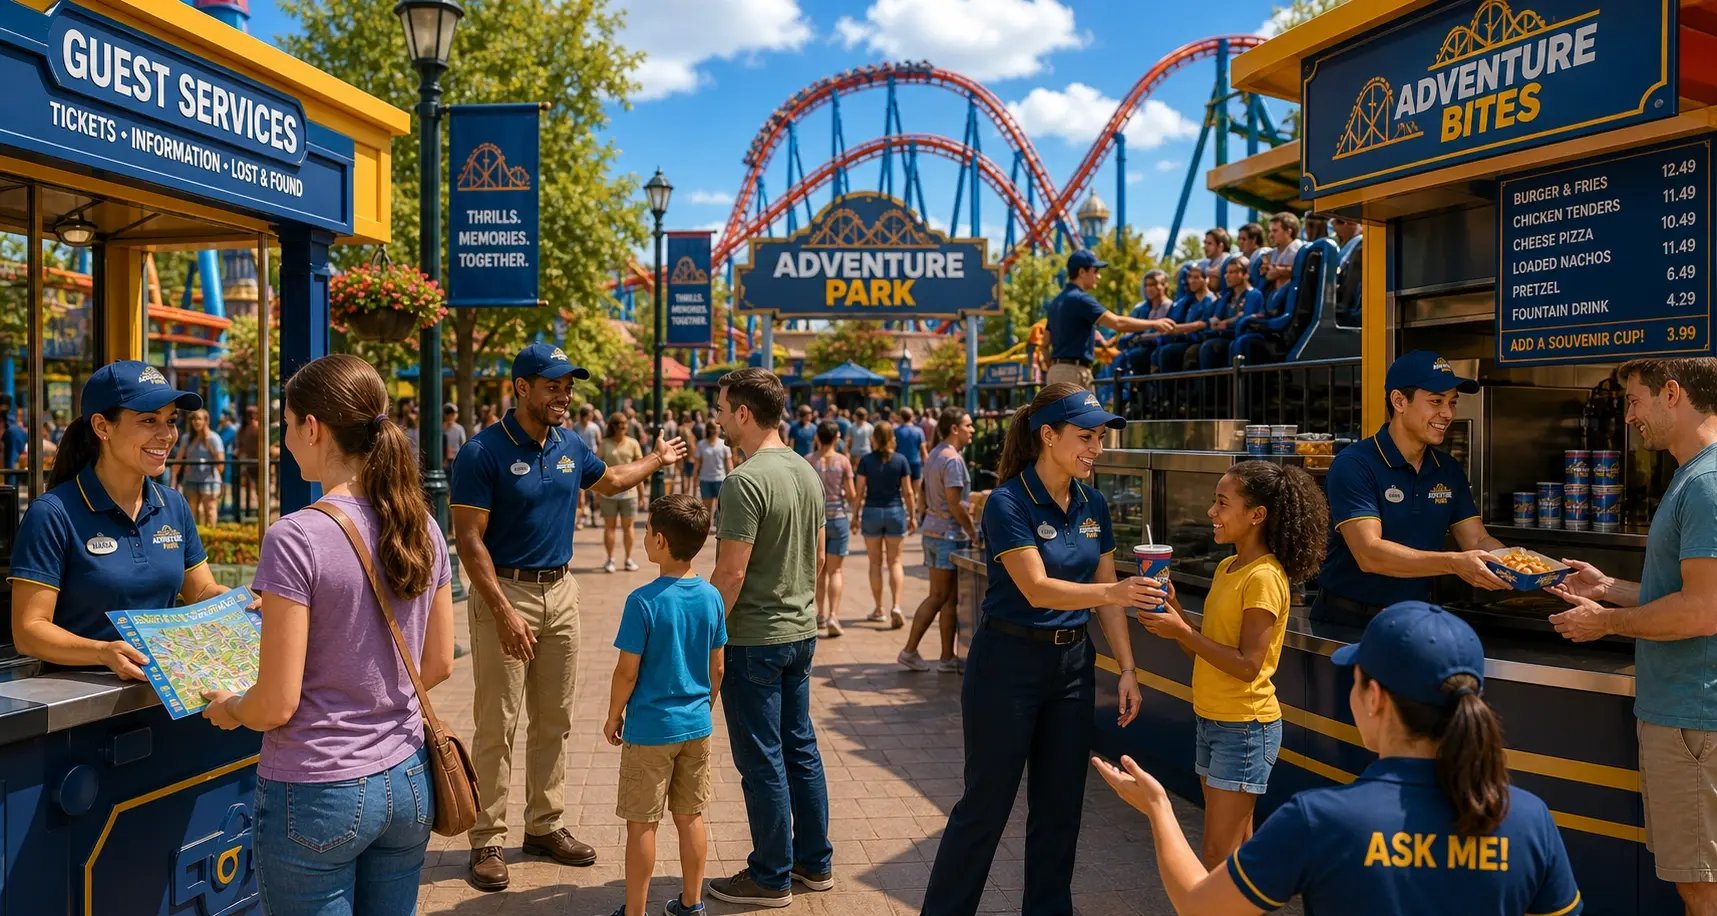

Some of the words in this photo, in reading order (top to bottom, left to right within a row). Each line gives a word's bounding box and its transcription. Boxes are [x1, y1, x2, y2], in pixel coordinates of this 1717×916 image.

[1394, 22, 1598, 120] ADVENTURE
[62, 28, 170, 108] GUEST
[178, 73, 297, 154] SERVICES
[1440, 82, 1543, 143] BITES
[49, 101, 117, 143] TICKETS
[131, 127, 221, 173] INFORMATION
[231, 158, 258, 183] LOST
[260, 170, 268, 187] &
[270, 173, 303, 197] FOUND
[1514, 186, 1559, 205] BURGER
[1563, 184, 1571, 196] &
[1575, 176, 1608, 194] FRIES
[1662, 159, 1696, 178] 12.49
[466, 209, 521, 224] THRILLS.
[1513, 209, 1563, 228] CHICKEN
[1566, 199, 1621, 219] TENDERS
[1663, 185, 1696, 203] 11.49
[459, 231, 530, 246] MEMORIES.
[1513, 234, 1555, 251] CHEESE
[1559, 228, 1594, 244] PIZZA
[1661, 211, 1696, 229] 10.49
[458, 252, 529, 268] TOGETHER.
[773, 252, 965, 278] ADVENTURE
[1513, 257, 1557, 275] LOADED
[1561, 250, 1612, 268] NACHOS
[1662, 238, 1696, 255] 11.49
[825, 279, 917, 306] PARK
[1512, 281, 1560, 298] PRETZEL
[1666, 265, 1696, 281] 6.49
[1512, 304, 1568, 321] FOUNTAIN
[1572, 300, 1609, 315] DRINK
[1666, 291, 1696, 307] 4.29
[1510, 338, 1534, 352] ADD
[1537, 337, 1545, 350] A
[1548, 332, 1610, 349] SOUVENIR
[1613, 329, 1645, 345] CUP!
[1667, 325, 1696, 341] 3.99
[1363, 831, 1437, 868] ASK
[1447, 834, 1510, 872] ME!
